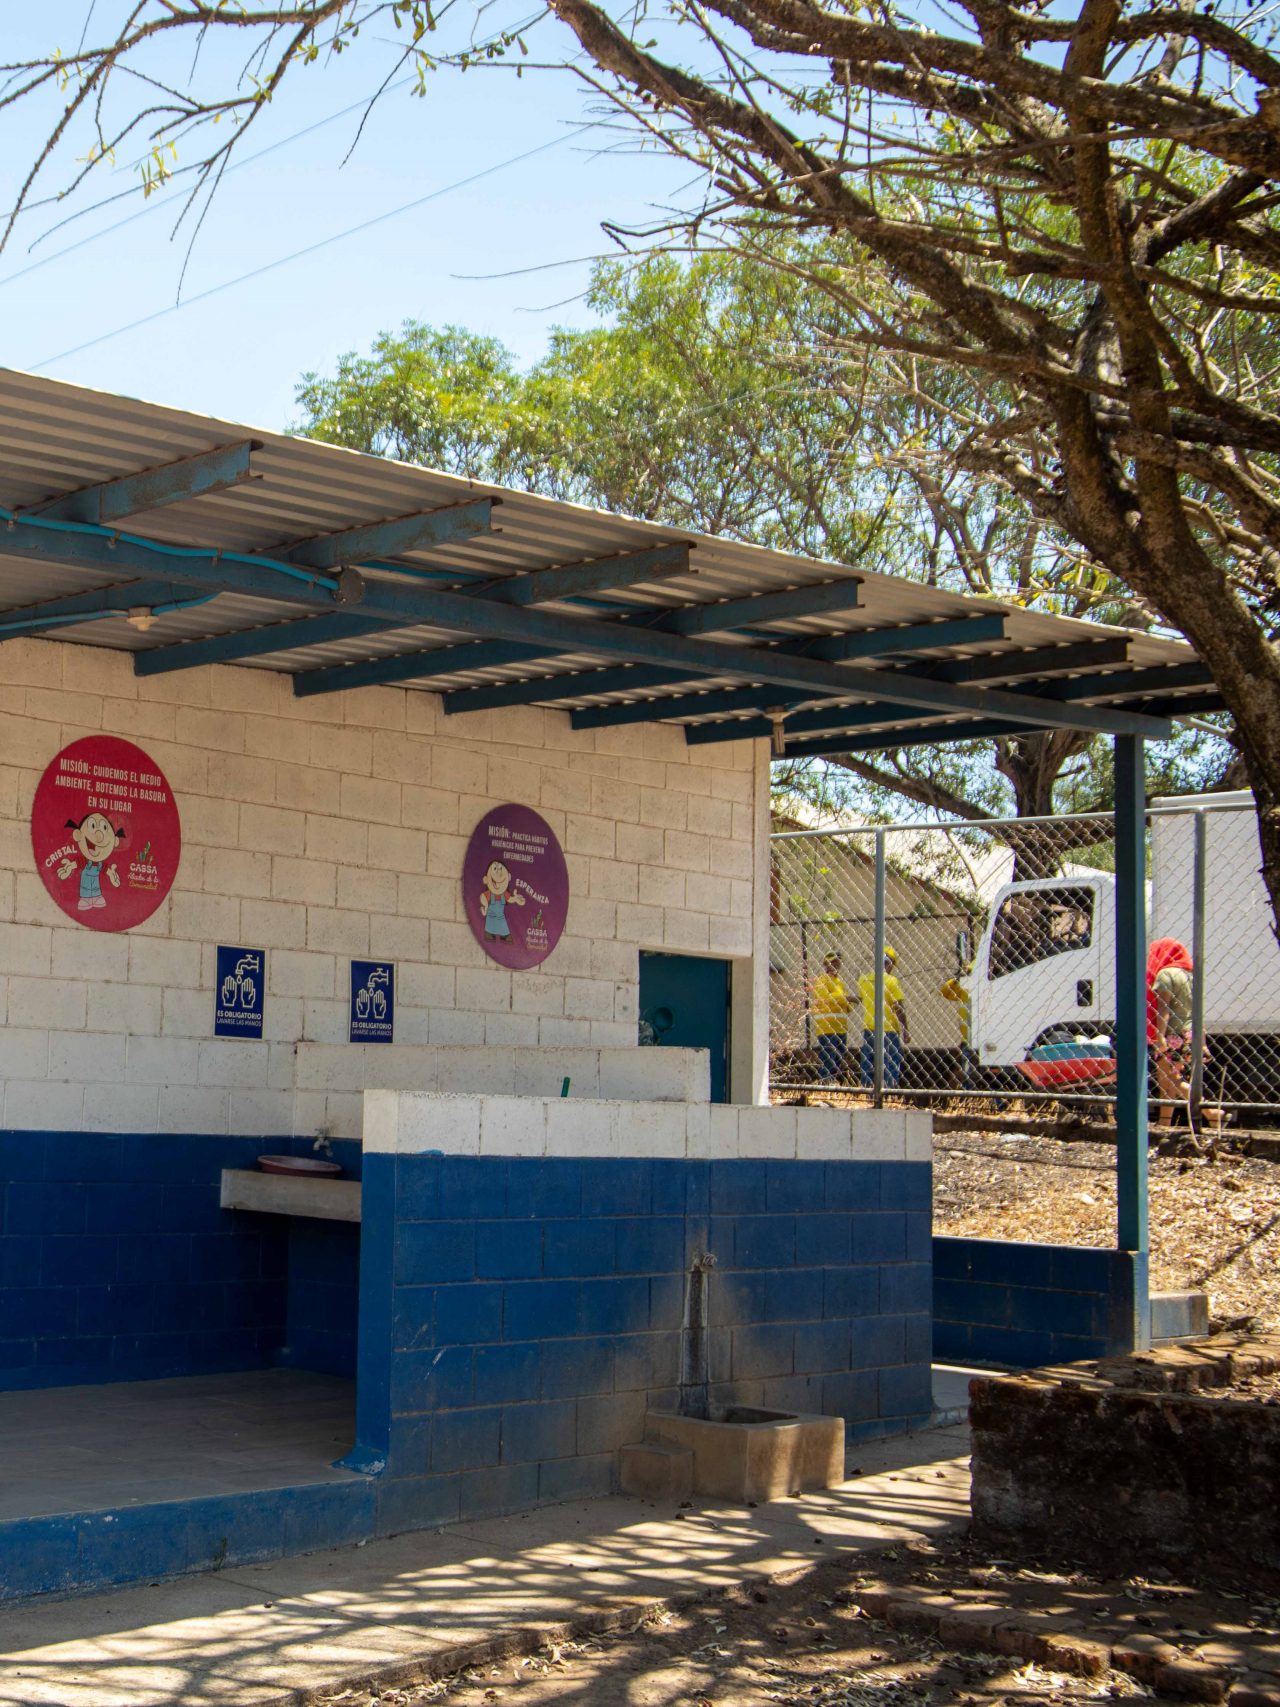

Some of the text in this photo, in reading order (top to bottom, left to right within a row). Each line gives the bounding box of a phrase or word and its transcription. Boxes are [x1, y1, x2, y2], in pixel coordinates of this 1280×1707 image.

[60, 758, 161, 787] MISIÓN: CUIDEMOS EL MEDIO
[55, 775, 166, 803] AMBIENTE, BOTEMOS LA BASURA
[88, 796, 132, 813] EN SU LUGAR
[488, 825, 511, 839] MISIÓN:
[515, 843, 525, 852] PARA
[45, 844, 78, 867] CRISTAL
[129, 862, 158, 875] CASSA
[515, 878, 550, 904] ESPERANZA
[527, 927, 548, 937] CASSA
[224, 1010, 262, 1020] OBLIGATORIO
[359, 1022, 392, 1030] OBLIGATORIO
